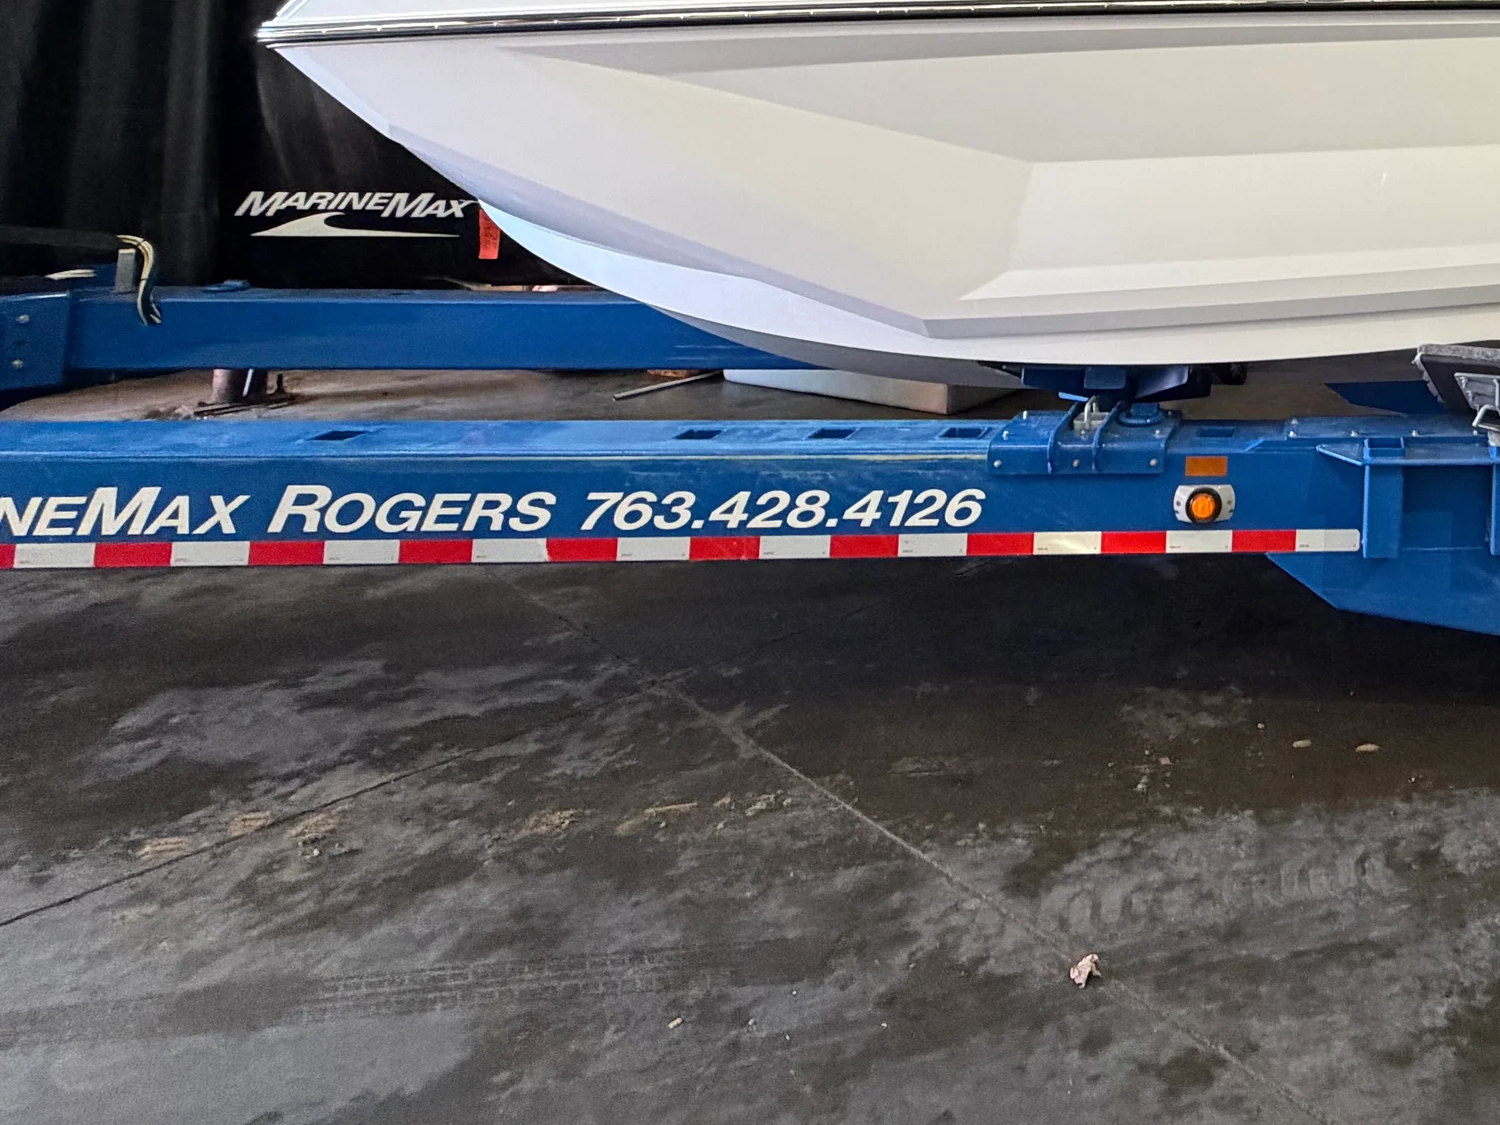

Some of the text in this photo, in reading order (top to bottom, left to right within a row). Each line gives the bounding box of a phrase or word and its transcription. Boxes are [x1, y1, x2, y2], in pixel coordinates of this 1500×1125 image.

[235, 191, 479, 218] MARINEMAX
[266, 482, 557, 535] ROGERS
[580, 488, 985, 531] 763.428.4126
